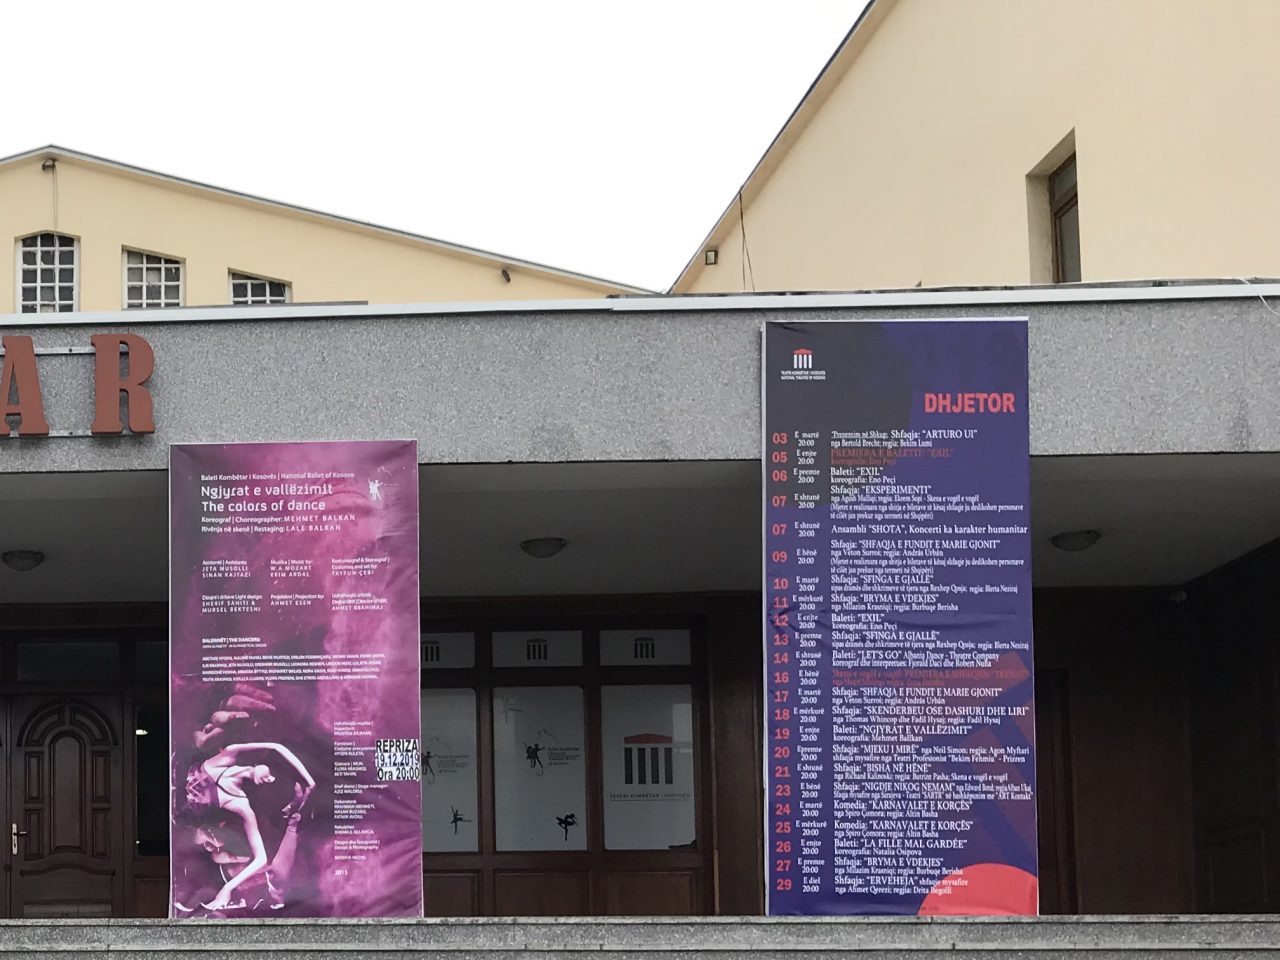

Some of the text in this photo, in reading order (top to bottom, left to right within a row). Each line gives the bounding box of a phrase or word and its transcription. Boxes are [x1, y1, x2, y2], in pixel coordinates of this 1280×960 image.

[925, 393, 1015, 413] DHJETOR
[772, 432, 788, 444] 03
[891, 430, 920, 441] Shfaqja:
[772, 452, 788, 463] 05
[772, 470, 788, 482] 06
[830, 467, 854, 476] Baleti:
[201, 484, 333, 499] Ngjyrat e vallëzimit
[830, 486, 860, 496] Shfaqja:
[201, 500, 326, 512] The colors of dance
[772, 495, 787, 507] 07
[201, 516, 231, 524] Koreograf
[235, 516, 283, 524] Choreographer:
[772, 524, 787, 535] 07
[831, 525, 867, 534] Ansambli
[909, 525, 941, 534] Koncerti
[943, 525, 953, 534] ka
[954, 525, 986, 534] karakter
[988, 524, 1028, 534] humanitar
[831, 540, 857, 550] Shfaqja:
[898, 540, 903, 548] E
[904, 540, 934, 549] FUNDIT
[935, 540, 940, 549] E
[942, 540, 968, 549] MARIE
[772, 551, 788, 563] 09
[773, 578, 788, 590] 10
[831, 575, 858, 586] Shfaqja:
[895, 575, 900, 583] E
[773, 597, 788, 608] 11
[831, 594, 859, 604] Shfaqja:
[895, 594, 900, 602] E
[773, 615, 788, 627] 12
[773, 634, 789, 646] 13
[773, 652, 789, 664] 14
[832, 651, 856, 659] Baleti:
[926, 652, 944, 660] Dance
[949, 652, 971, 660] Theatre
[972, 652, 999, 661] Company
[774, 672, 789, 683] 16
[774, 691, 789, 703] 17
[832, 688, 859, 698] Shfaqja:
[900, 688, 904, 696] E
[906, 688, 935, 696] FUNDIT
[937, 688, 942, 696] E
[944, 688, 969, 697] MARIE
[775, 708, 790, 720] 18
[832, 707, 861, 717] Shfaqja:
[926, 707, 943, 715] OSE
[945, 707, 984, 715] DASHURI
[987, 707, 1006, 716] DHE
[775, 728, 790, 740] 19
[833, 725, 857, 734] Baleti:
[906, 726, 911, 734] E
[376, 740, 418, 752] REPRIZA
[832, 745, 859, 755] Shfaqja:
[774, 747, 790, 758] 20
[376, 753, 419, 767] 19.12.2019
[377, 768, 393, 780] Ora
[396, 767, 420, 779] 20:00
[775, 766, 790, 778] 21
[833, 764, 861, 774] Shfaqja:
[893, 762, 904, 772] NË
[776, 785, 791, 796] 23
[776, 804, 791, 815] 24
[834, 800, 867, 809] Komedia:
[931, 801, 935, 810] E
[776, 822, 791, 833] 25
[776, 841, 791, 853] 26
[834, 839, 858, 848] Baleti:
[878, 839, 902, 848] FILLE
[904, 840, 925, 848] MAL
[776, 860, 791, 871] 27
[834, 858, 862, 868] Shfaqja:
[900, 858, 904, 866] E
[777, 879, 792, 891] 29
[834, 876, 864, 888] Shfaqja:
